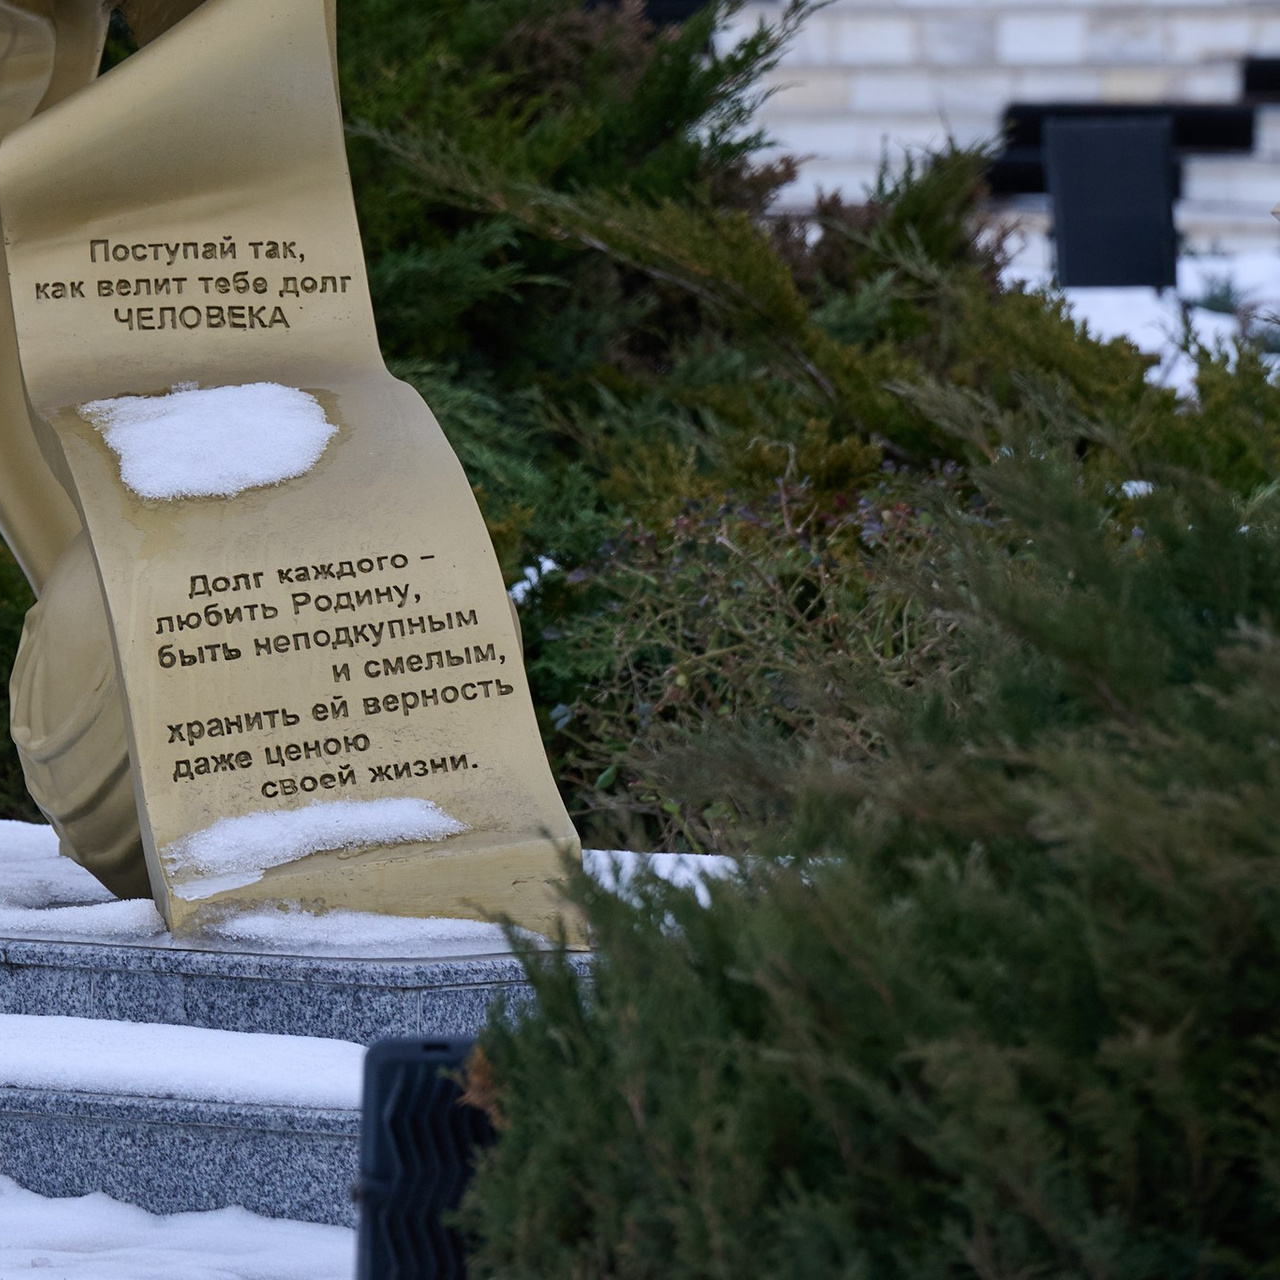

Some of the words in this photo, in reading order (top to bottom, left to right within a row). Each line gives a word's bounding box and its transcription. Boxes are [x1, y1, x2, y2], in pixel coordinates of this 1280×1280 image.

[89, 235, 237, 266] Поступай
[248, 239, 305, 263] так,
[35, 279, 85, 300] как
[97, 276, 188, 298] велит
[198, 270, 268, 295] тебе
[278, 274, 352, 299] долг
[114, 305, 290, 331] ЧЕЛОВЕКА
[188, 572, 265, 600] Долг
[277, 552, 409, 585] каждого
[155, 600, 278, 635] любить
[290, 582, 421, 615] Родину,
[157, 641, 242, 670] быть
[254, 608, 479, 657] неподкупным
[332, 663, 350, 683] и
[363, 642, 507, 679] смелым,
[167, 708, 300, 744] хранить
[311, 695, 349, 722] ей
[362, 677, 514, 719] верность
[172, 751, 253, 783] даже
[265, 733, 371, 769] ценою
[260, 763, 357, 799] своей
[367, 752, 479, 784] жизни.
